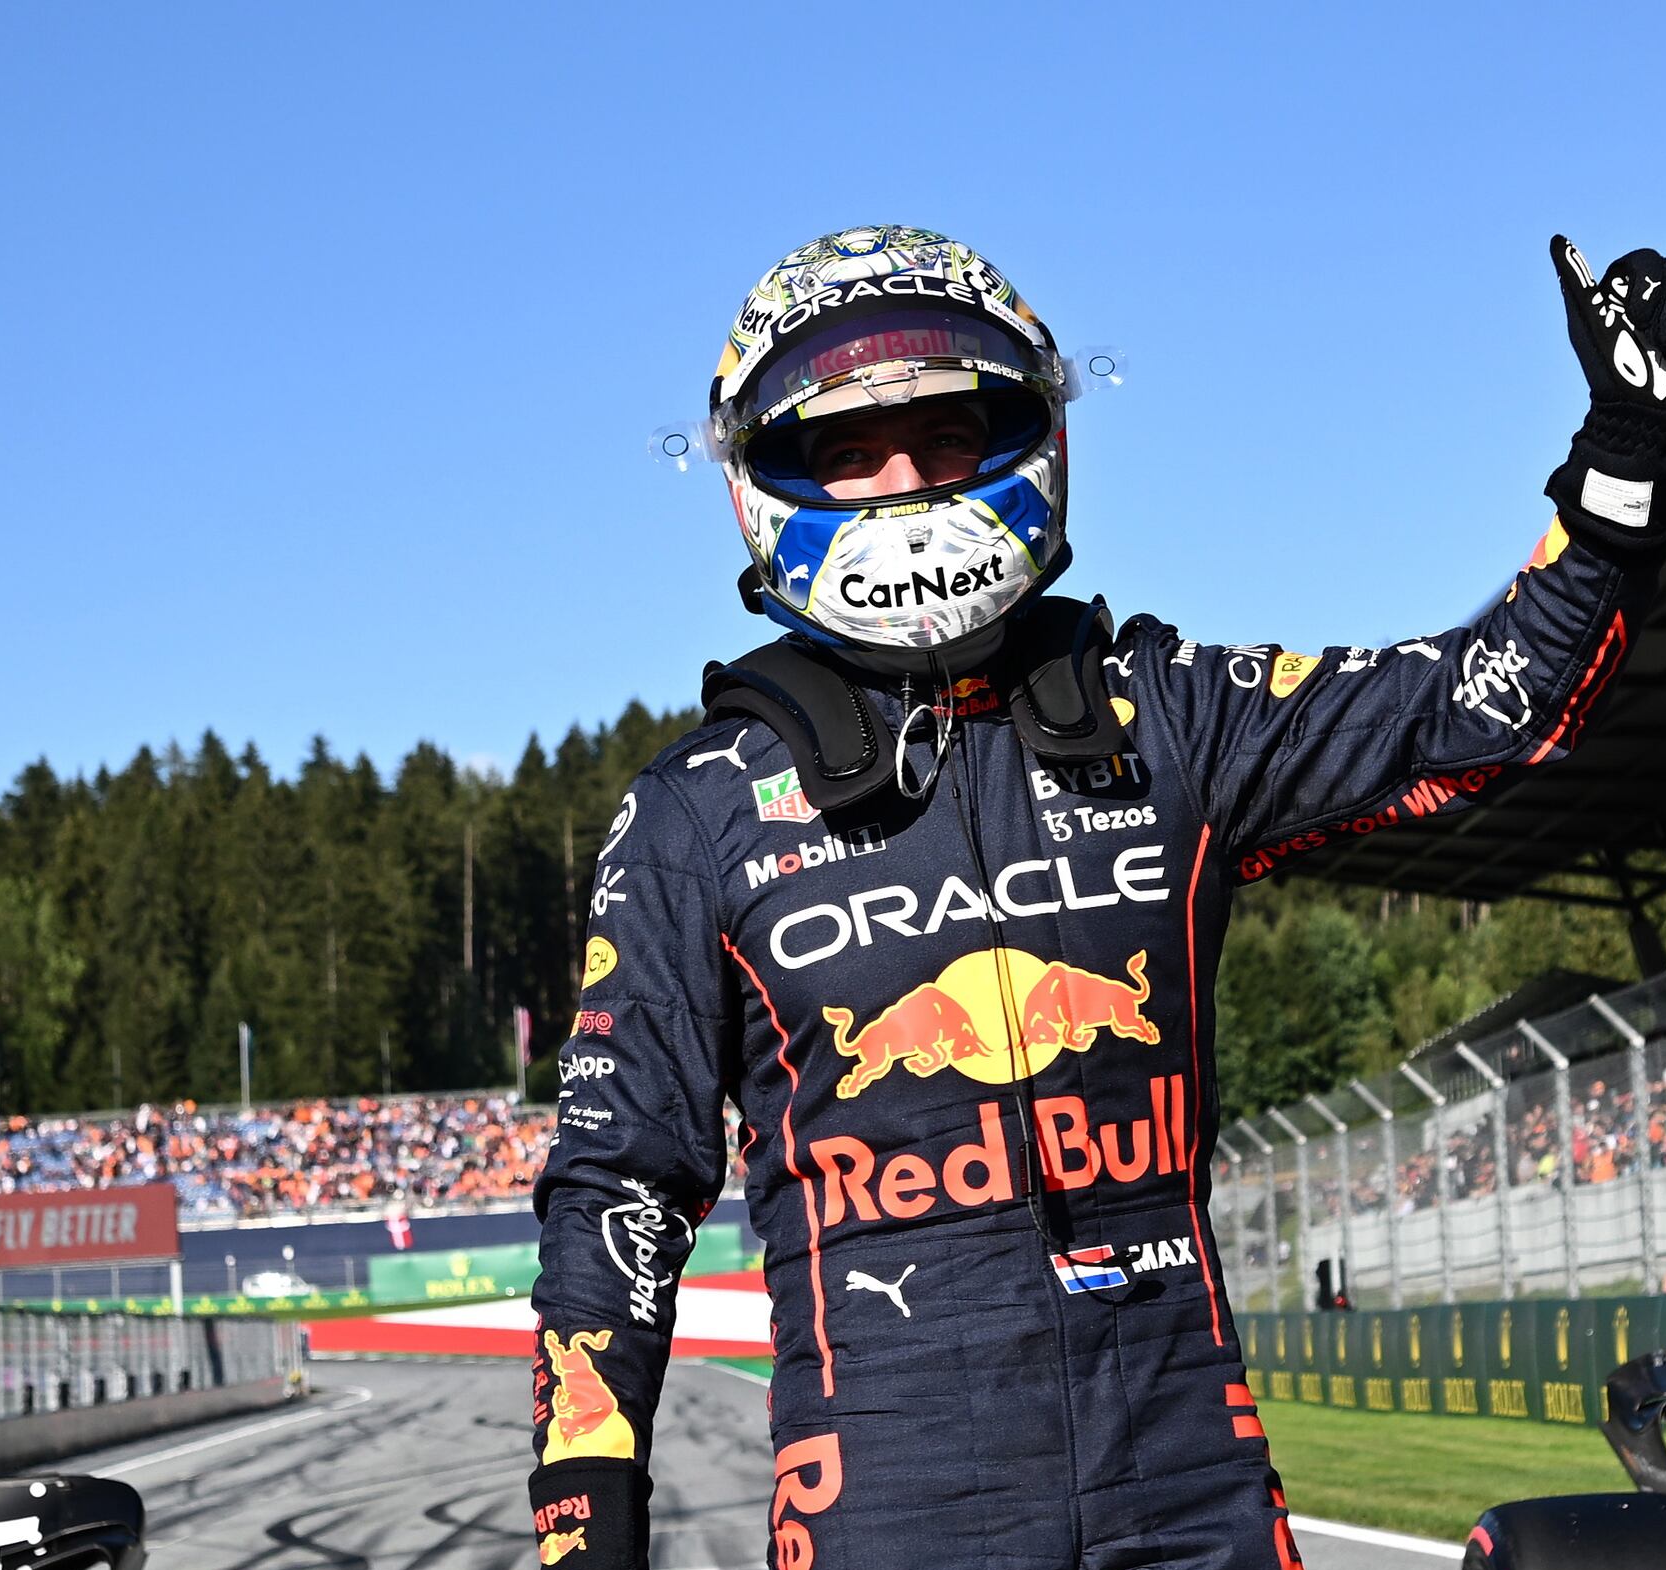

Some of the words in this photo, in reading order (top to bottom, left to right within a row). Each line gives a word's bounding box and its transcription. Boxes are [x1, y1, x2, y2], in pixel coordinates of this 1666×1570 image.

[777, 274, 976, 334] ORACLE
[840, 553, 1004, 608] CarNext
[1031, 753, 1140, 801] BYBIT
[1074, 805, 1157, 833] Tezos
[744, 832, 847, 890] Mobil
[769, 844, 1171, 970] ORACLE
[809, 1102, 1015, 1228] Red
[1035, 1074, 1189, 1192] Bull
[42, 1202, 137, 1250] BETTER
[1131, 1236, 1197, 1274] MAX
